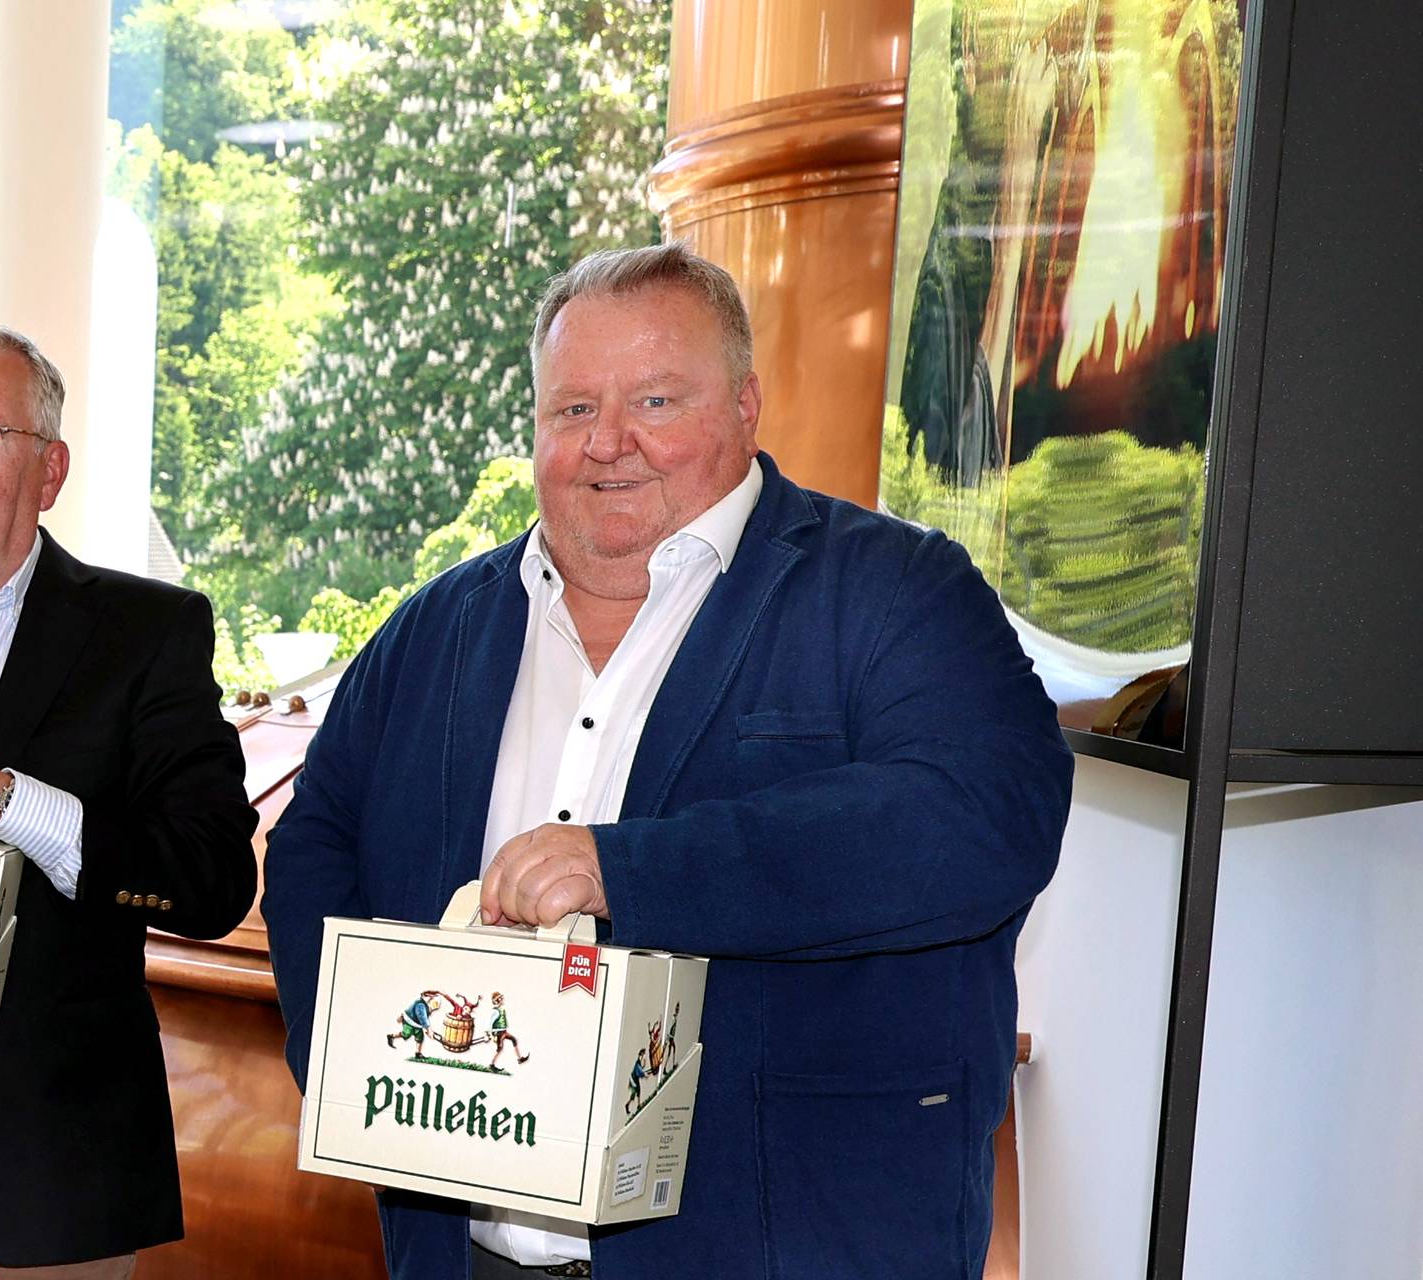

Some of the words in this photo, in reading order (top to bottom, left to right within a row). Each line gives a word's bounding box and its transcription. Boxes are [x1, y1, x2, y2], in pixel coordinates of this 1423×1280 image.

[571, 954, 591, 967] FÜR
[567, 966, 592, 978] DICH
[364, 1075, 536, 1147] Pülleken
